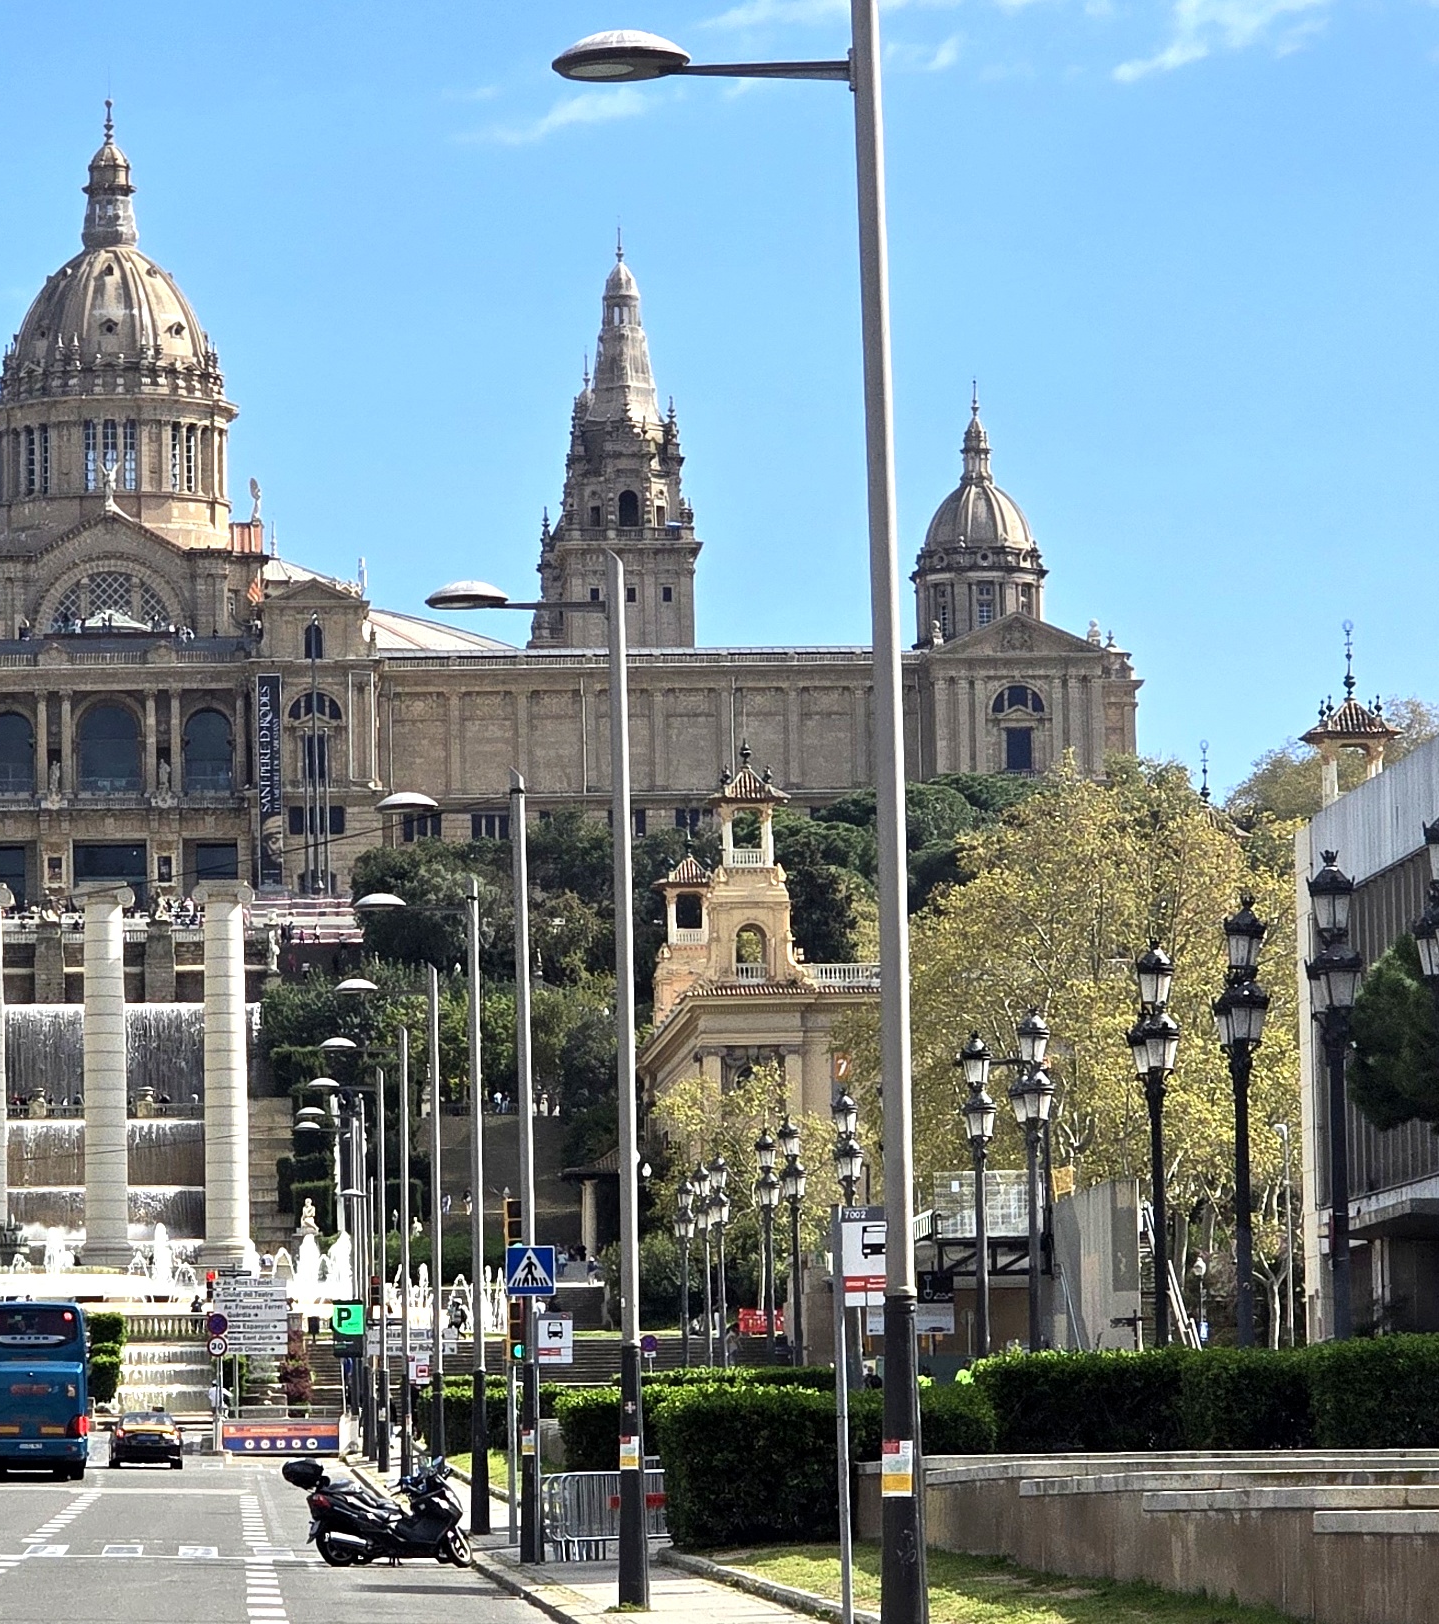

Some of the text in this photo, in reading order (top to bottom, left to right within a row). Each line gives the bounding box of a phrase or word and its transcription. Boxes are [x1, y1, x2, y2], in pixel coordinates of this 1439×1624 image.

[844, 1211, 867, 1219] 7002
[337, 1307, 352, 1328] P
[242, 1323, 271, 1331] Espanyol
[211, 1342, 224, 1351] 30
